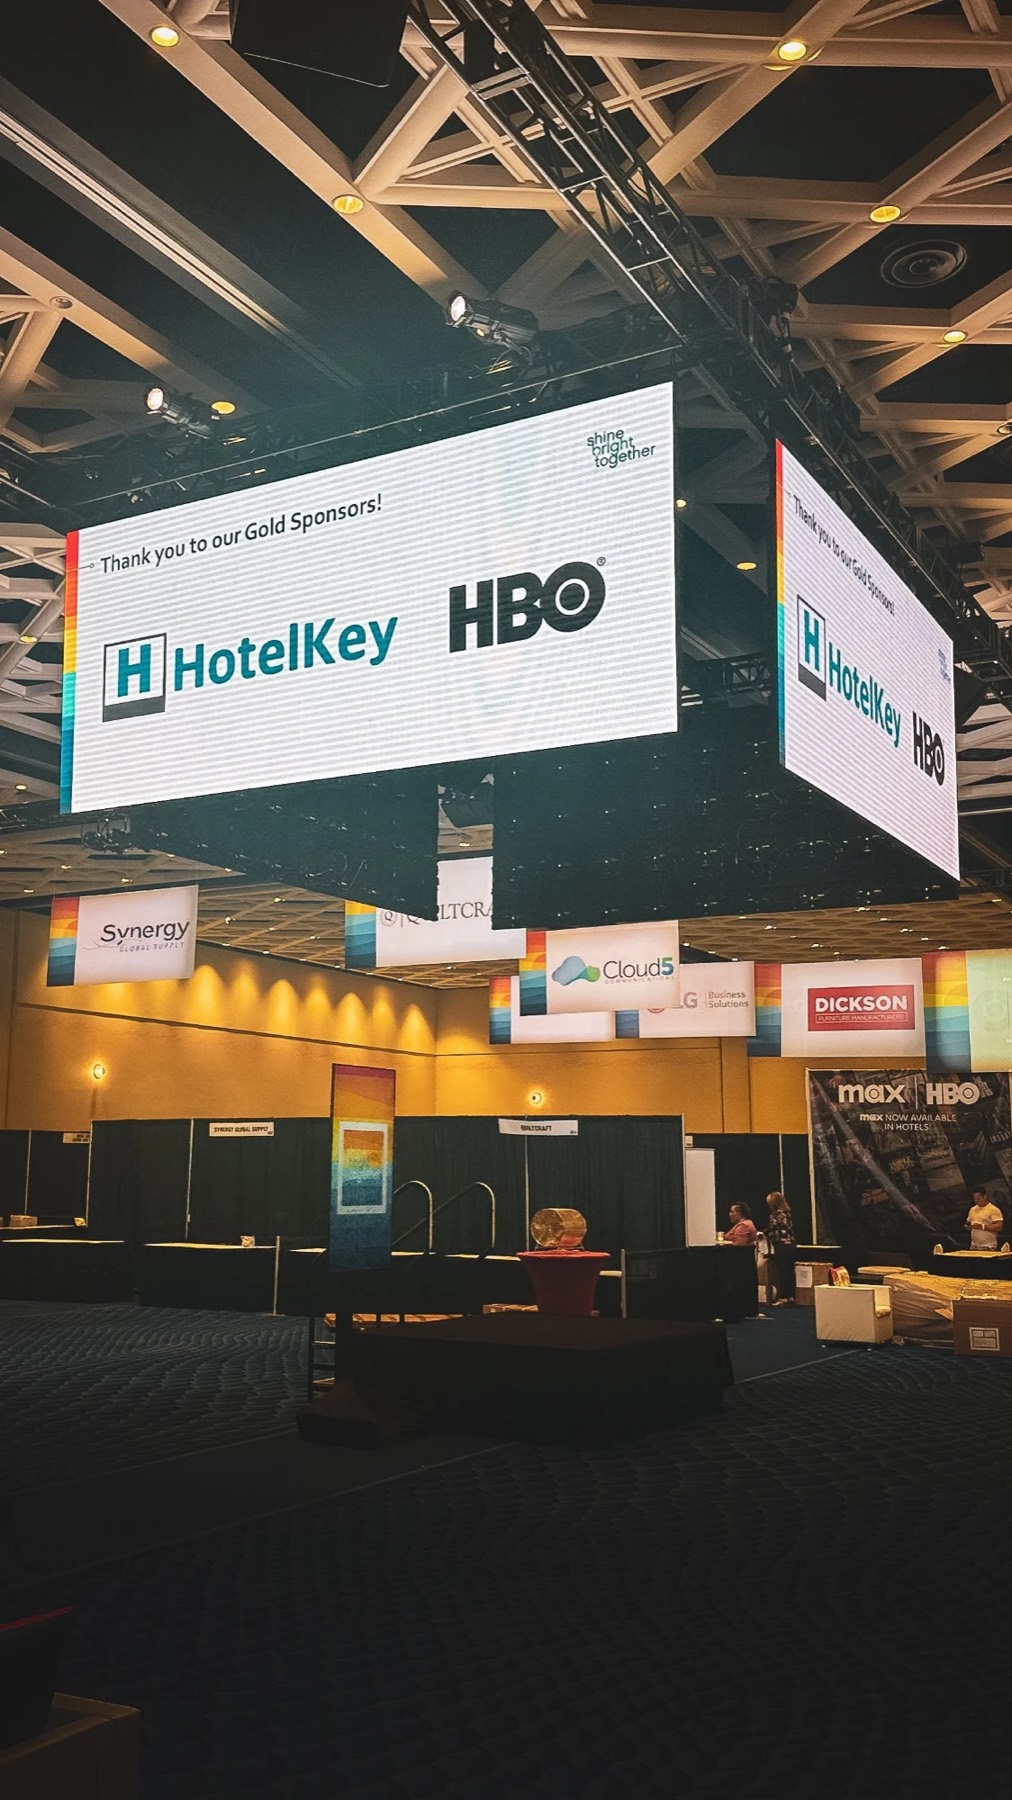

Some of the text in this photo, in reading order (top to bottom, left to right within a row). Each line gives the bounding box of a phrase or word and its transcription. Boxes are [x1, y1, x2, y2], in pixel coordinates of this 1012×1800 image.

[587, 429, 624, 446] shine
[592, 437, 635, 456] bright
[594, 445, 656, 468] together
[101, 493, 383, 574] Thank you to our Gold Sponsors!
[793, 494, 895, 617] Thank you to our Gold Sponsors!
[117, 617, 399, 698] H HotelKey
[804, 609, 901, 748] H HotelKey
[912, 711, 945, 787] HBO
[100, 921, 190, 946] Synergy
[119, 941, 185, 953] GLOBAL SUPPLY
[602, 957, 674, 979] Cloud5
[708, 991, 746, 999] Business
[708, 1000, 749, 1008] Solutions
[815, 995, 908, 1013] DICKSON
[851, 1013, 905, 1021] MANUFACTURERS
[838, 1084, 906, 1104] max
[926, 1082, 980, 1105] HBO
[859, 1113, 957, 1122] max NOW AVAILABLE
[896, 1123, 931, 1131] HOTELS!
